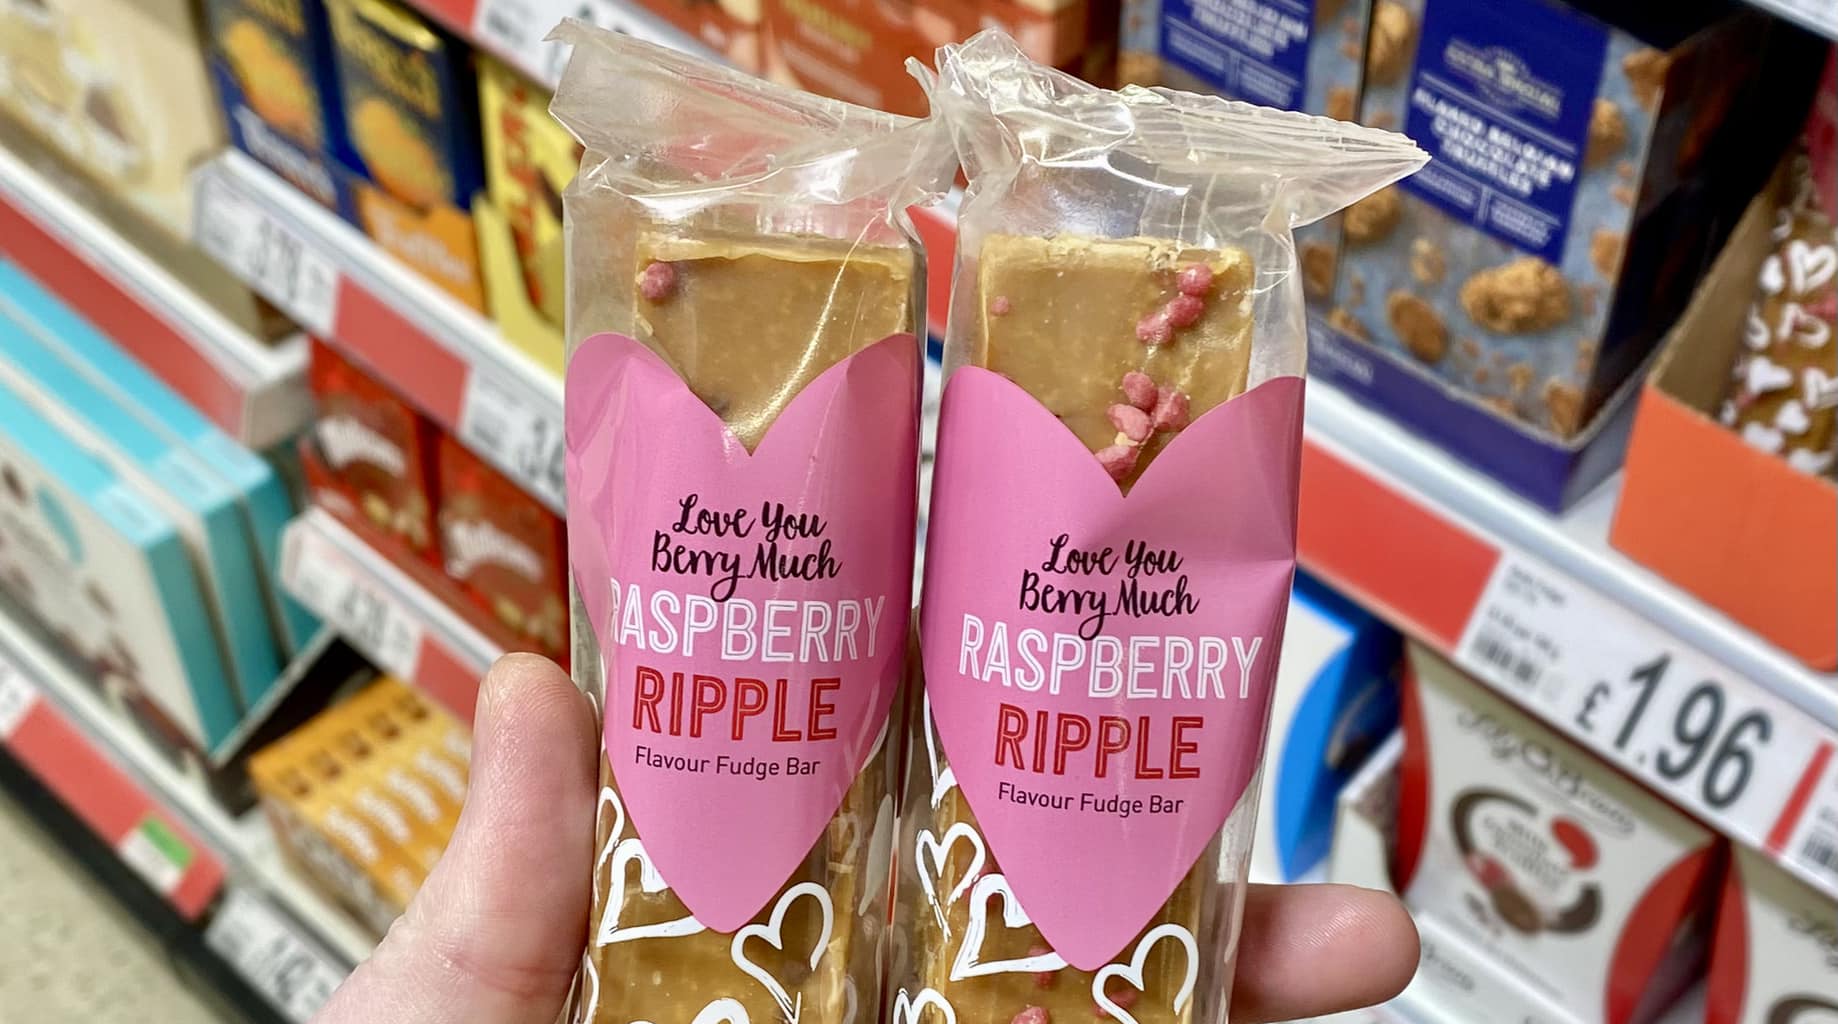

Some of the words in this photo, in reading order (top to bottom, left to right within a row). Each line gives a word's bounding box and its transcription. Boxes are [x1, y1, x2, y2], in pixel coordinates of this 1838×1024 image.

[672, 494, 756, 538] Love
[762, 501, 827, 543] You
[652, 530, 748, 602] Berry
[747, 539, 843, 581] Much
[1042, 534, 1119, 575] Love
[1124, 540, 1184, 578] You
[1019, 569, 1111, 640] Berry
[1112, 575, 1200, 618] Much
[959, 613, 1263, 700] RASPBERRY
[632, 666, 841, 742] RIPPLE
[1575, 653, 1774, 810] £1.96
[635, 745, 711, 773] Flavour
[716, 755, 780, 780] Fudge
[786, 757, 820, 776] Bar
[994, 703, 1204, 780] RIPPLE
[998, 782, 1075, 810] Flavour
[1080, 793, 1144, 818] Fudge
[1150, 795, 1184, 813] Bar
